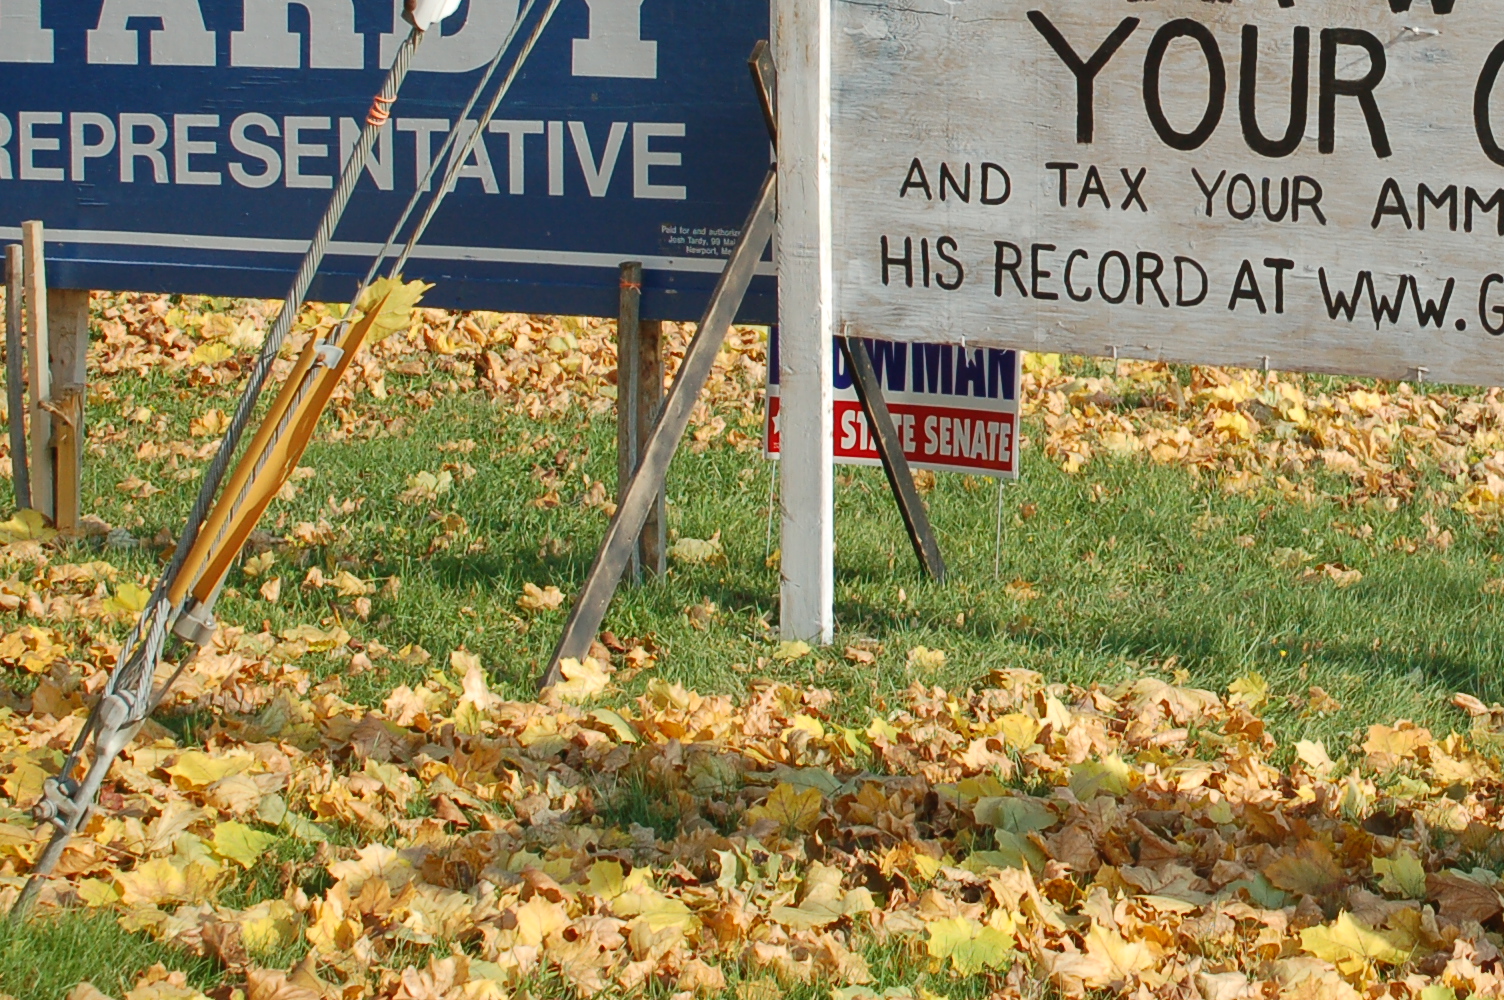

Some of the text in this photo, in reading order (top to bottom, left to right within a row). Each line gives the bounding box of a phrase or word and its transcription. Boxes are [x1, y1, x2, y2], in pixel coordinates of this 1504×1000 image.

[1027, 10, 1391, 158] YOUR
[900, 157, 1011, 206] AND
[1045, 161, 1148, 213] TAX
[1191, 168, 1327, 225] YOUR
[661, 225, 677, 234] Paid
[679, 226, 690, 235] for
[692, 227, 707, 236] and
[668, 235, 685, 244] Josh
[880, 235, 964, 291] HIS
[994, 241, 1208, 307] RECORD
[1228, 257, 1295, 314] AT
[840, 409, 1011, 463] STTE SENATE
